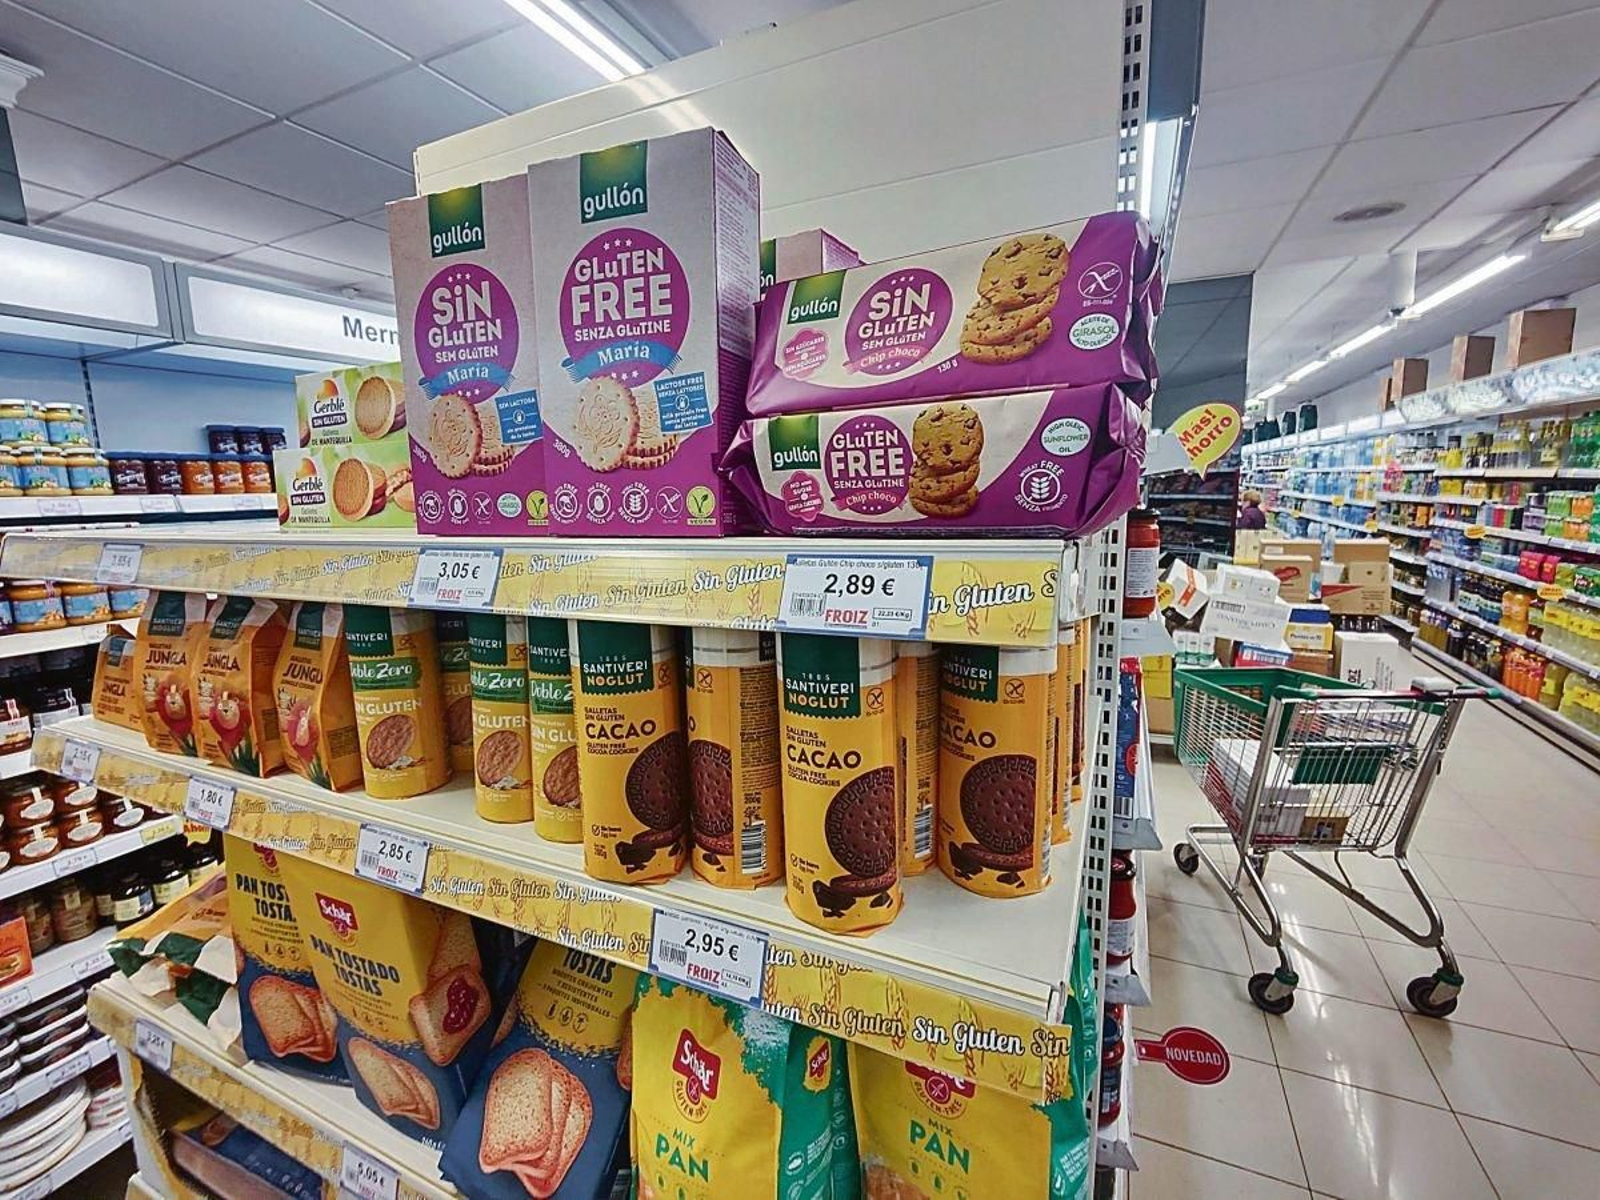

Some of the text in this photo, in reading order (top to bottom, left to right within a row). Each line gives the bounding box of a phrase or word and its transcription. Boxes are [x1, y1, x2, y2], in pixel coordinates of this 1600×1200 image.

[583, 183, 644, 218] gullón
[432, 221, 483, 248] gullón
[571, 273, 673, 327] FREE
[790, 296, 839, 321] gullón
[574, 325, 615, 343] SENZA
[1072, 324, 1117, 339] GIRASOL
[597, 341, 650, 367] María
[861, 340, 884, 351] SEM
[435, 349, 458, 363] SEM
[859, 346, 921, 368] Chip choco
[447, 363, 490, 383] María
[656, 376, 704, 391] LACTOSE FREE
[313, 398, 345, 414] Gerblé
[313, 414, 346, 427] SIN GLUTEN
[1047, 422, 1065, 434] HIGH
[1043, 433, 1089, 444] SUNFLOWER
[1187, 416, 1233, 461] horro
[773, 445, 818, 468] gullón
[830, 448, 905, 478] FREE
[1040, 460, 1065, 477] FREE
[292, 476, 323, 492] Gerblé
[834, 479, 864, 489] SENZA
[292, 494, 325, 505] SIN GLUTEN
[846, 490, 898, 507] Chip choco
[1014, 493, 1041, 513] SENZA
[438, 561, 481, 581] 3,05 €
[436, 588, 462, 600] FROIZ
[604, 584, 632, 607] Sin
[635, 578, 686, 601] Gluten
[691, 570, 723, 593] Sin
[724, 561, 786, 593] Gluten
[824, 573, 896, 599] 2,89 €
[928, 581, 1034, 617] in Gluten
[824, 608, 869, 625] FROIZ
[376, 662, 413, 679] Zero
[583, 660, 648, 674] SANTIVERI
[488, 672, 525, 690] Zero
[531, 679, 563, 700] Doble
[587, 672, 645, 687] NOGLUT
[785, 678, 855, 695] SANTIVERI
[788, 692, 850, 709] NOGLUT
[595, 713, 625, 722] GLUTEN
[548, 729, 577, 743] GLU
[585, 719, 657, 741] CACAO
[944, 721, 997, 749] ACAO
[786, 733, 826, 748] SIN GLUTEN
[787, 744, 862, 770] CACAO
[808, 776, 841, 787] COOKIES
[810, 770, 827, 779] FREE
[200, 788, 218, 805] 1,80
[378, 840, 413, 864] 2,85 €
[377, 865, 399, 880] FROIZ
[235, 873, 259, 896] PAN
[428, 876, 577, 900] Sin Gluten Sin Gluten Sin
[255, 897, 298, 923] TOSTA
[581, 928, 626, 952] Gluten
[684, 928, 740, 962] 2,95 €
[311, 934, 401, 984] PAN TOSTADO
[562, 948, 617, 985] TOSTAS
[332, 962, 383, 997] TOSTAS
[687, 963, 721, 984] FROIZ
[807, 1002, 1072, 1058] Sin Gluten Sin Gluten Sin
[680, 1039, 714, 1092] Schär
[1165, 1045, 1222, 1067] NOVEDAD
[926, 1117, 954, 1137] MIX
[672, 1127, 696, 1149] MIX
[908, 1118, 971, 1175] PAN
[655, 1131, 710, 1183] PAN
